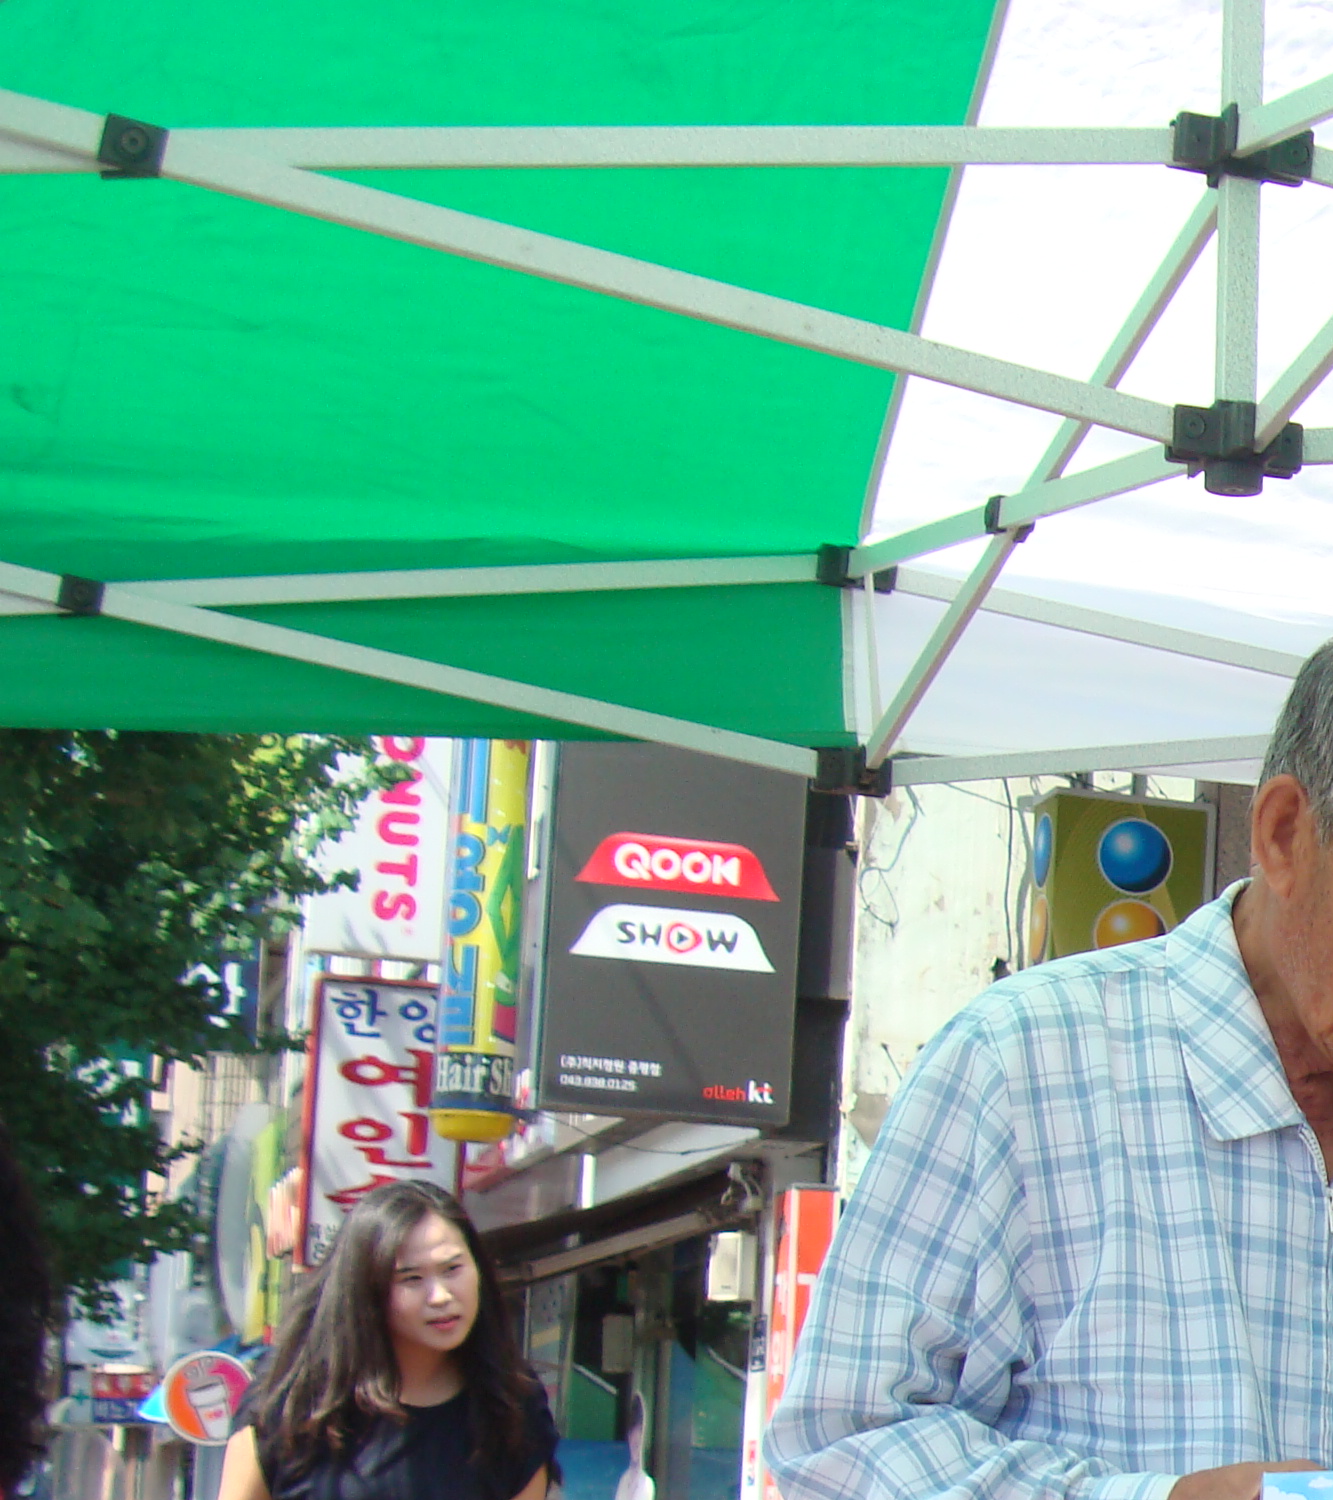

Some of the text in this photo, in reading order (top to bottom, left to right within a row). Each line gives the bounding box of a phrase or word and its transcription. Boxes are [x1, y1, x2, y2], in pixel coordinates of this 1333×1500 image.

[613, 842, 742, 887] QOOK
[616, 920, 739, 954] SHOW
[437, 1053, 486, 1096] Hair
[702, 1079, 775, 1105] olleh kt
